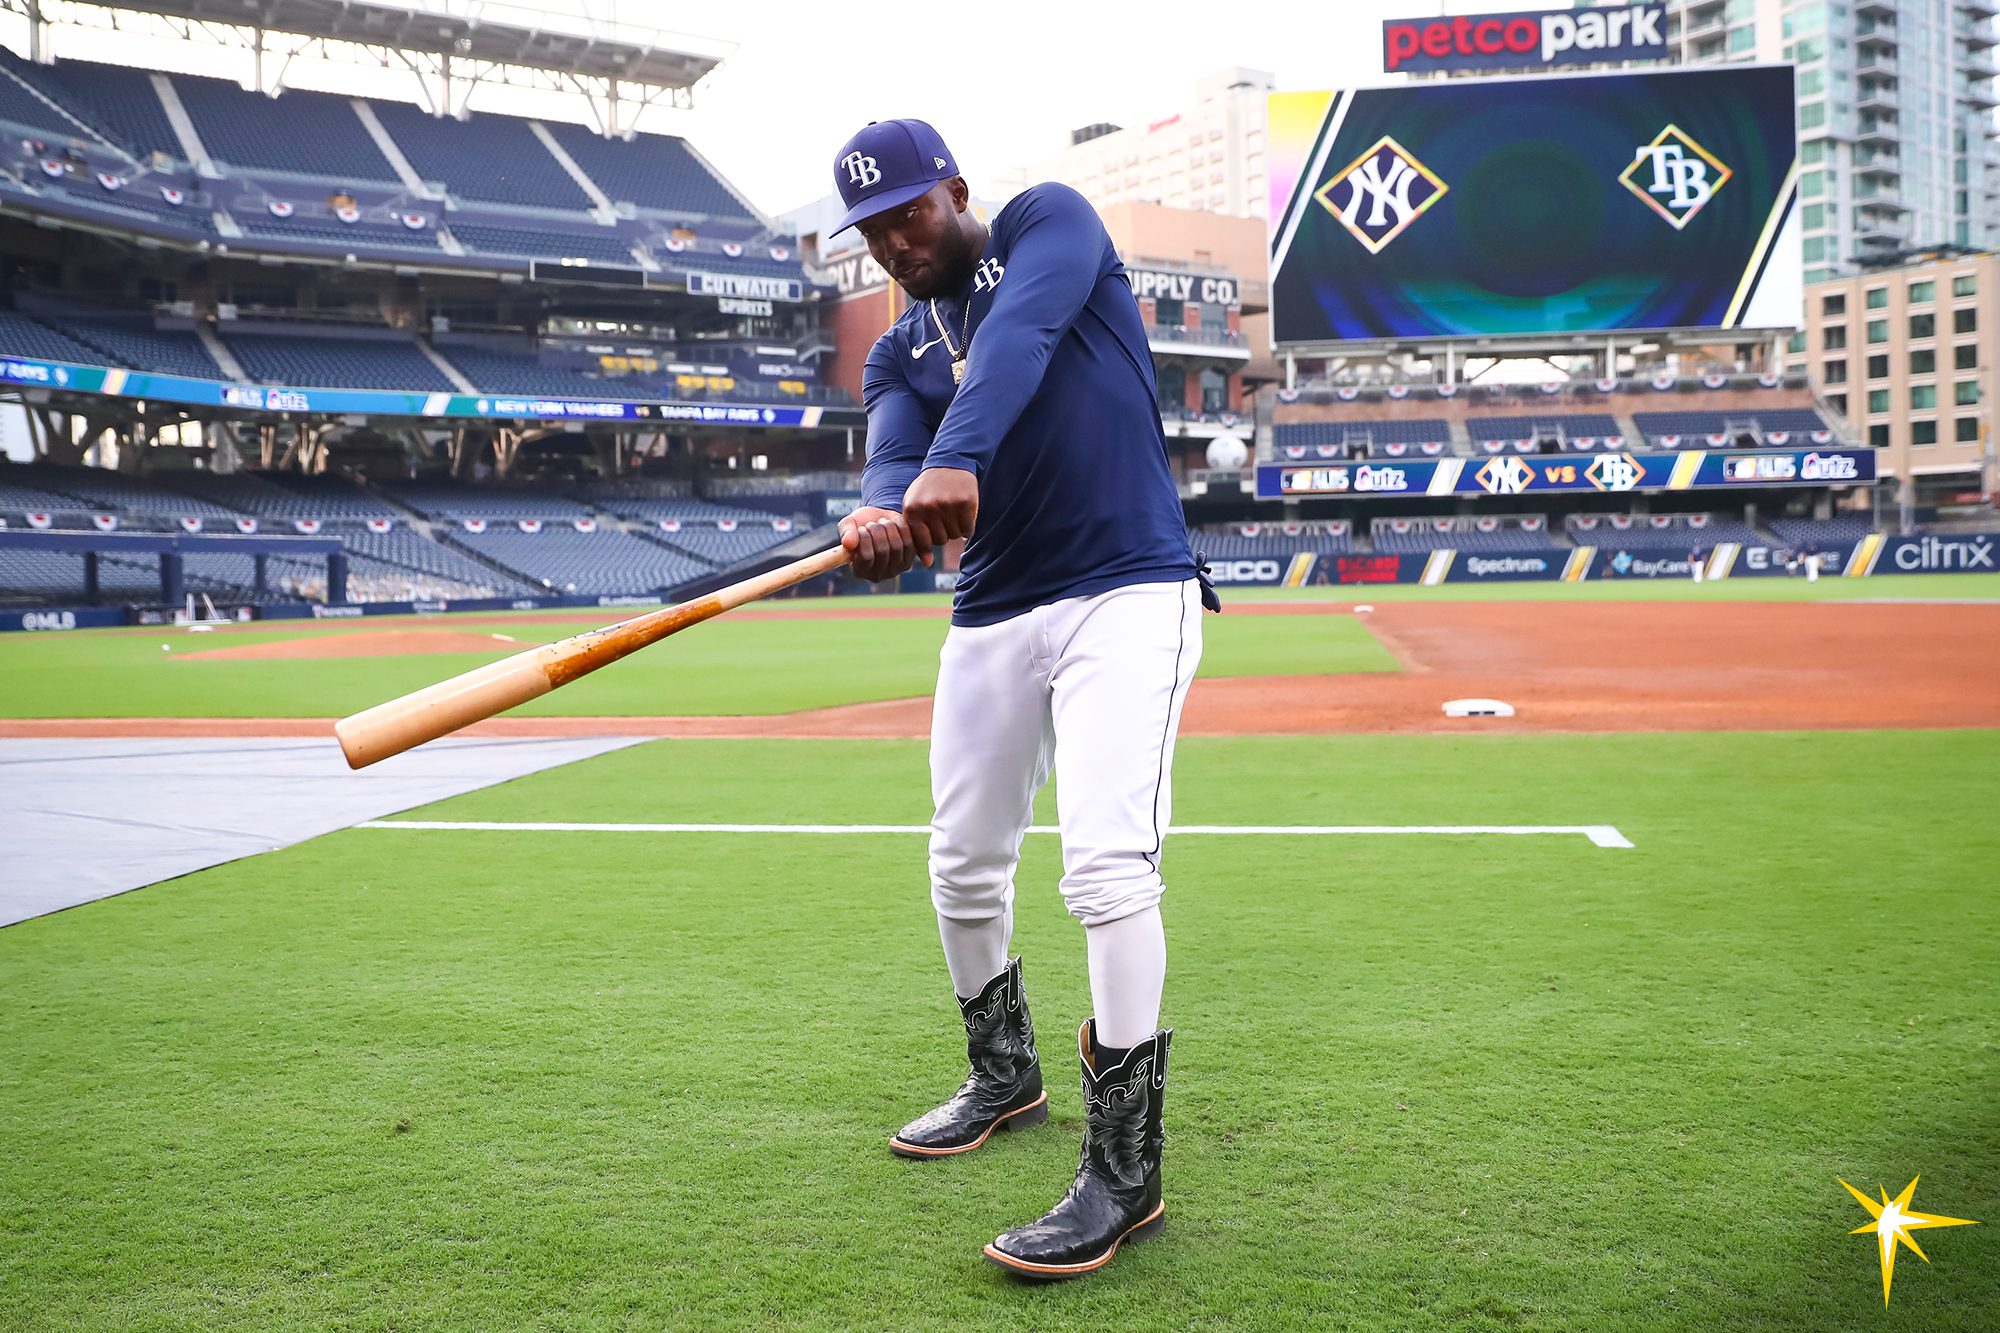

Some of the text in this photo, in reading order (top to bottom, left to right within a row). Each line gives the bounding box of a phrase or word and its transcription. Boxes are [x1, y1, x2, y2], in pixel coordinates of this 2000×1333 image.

[841, 151, 882, 188] TB
[1635, 144, 1711, 208] TB
[1340, 155, 1419, 227] NY
[703, 275, 790, 299] CUTWATER
[718, 298, 773, 317] SPIRITS
[1467, 556, 1542, 576] Spectrum
[1895, 536, 1994, 569] citrix
[22, 611, 76, 630] @MLB
